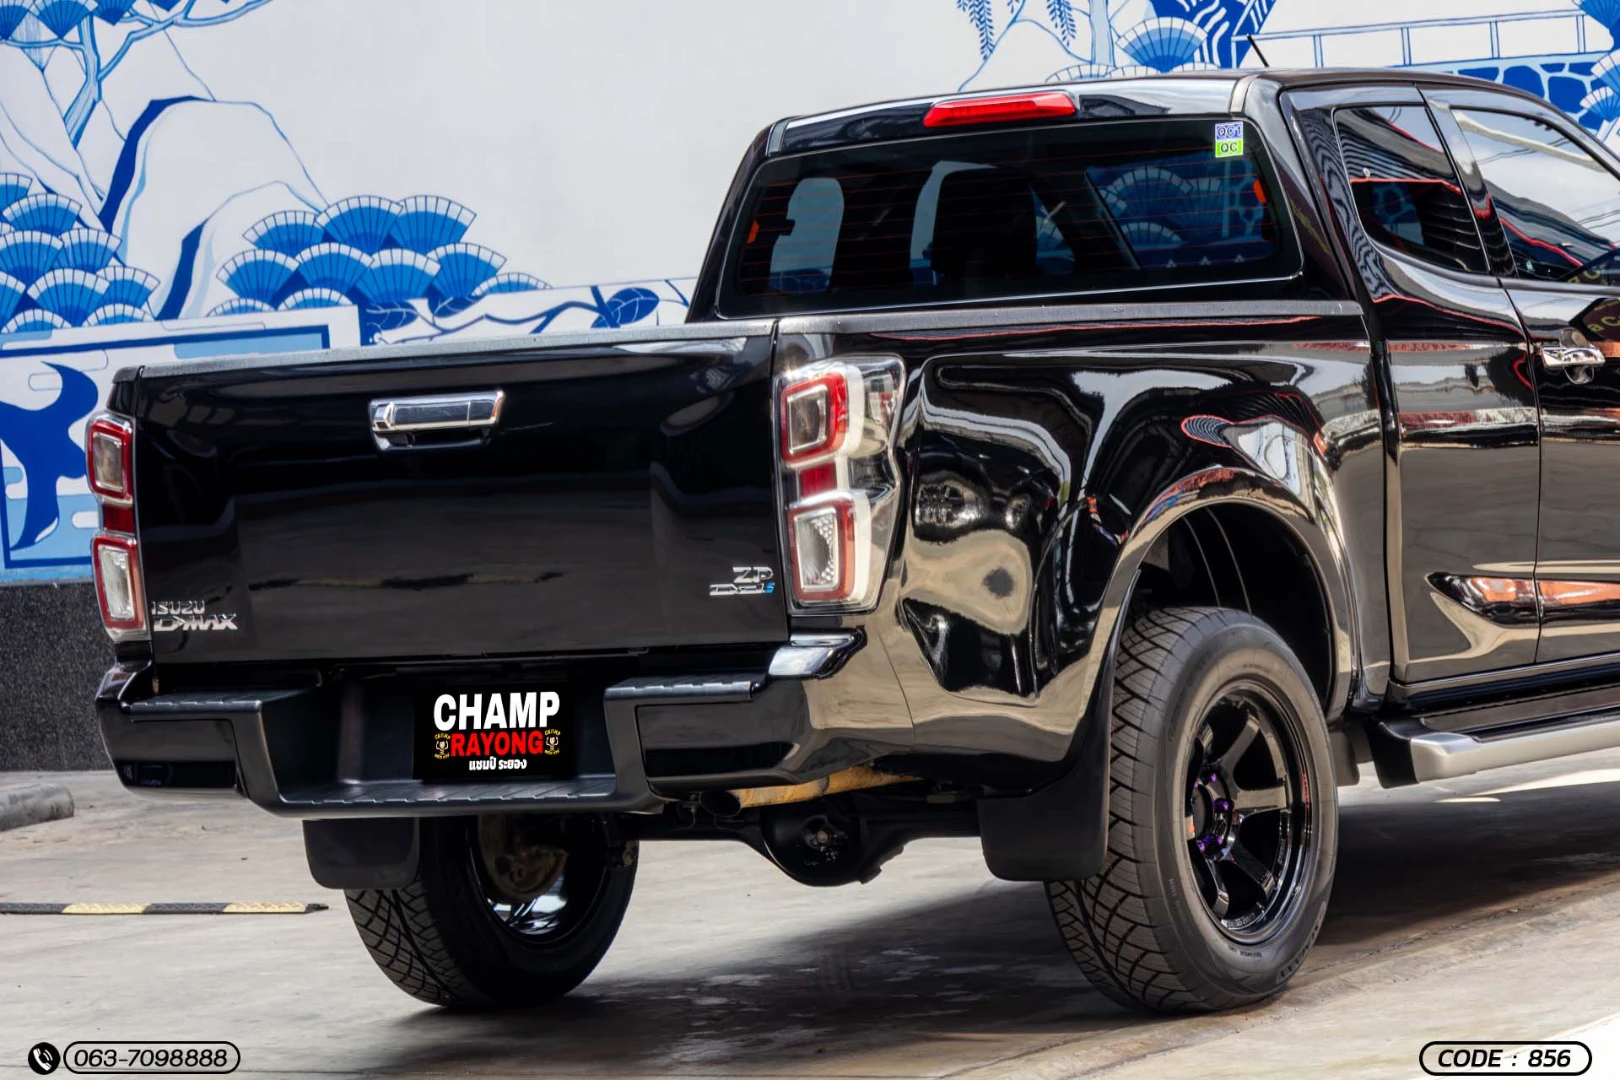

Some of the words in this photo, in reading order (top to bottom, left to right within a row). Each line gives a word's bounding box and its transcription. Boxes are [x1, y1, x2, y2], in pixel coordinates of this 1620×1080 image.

[1221, 143, 1238, 153] QC
[151, 600, 205, 615] ISUZU
[433, 691, 560, 731] CHAMP
[450, 730, 544, 757] RAYONG
[498, 759, 527, 770] ระยอง
